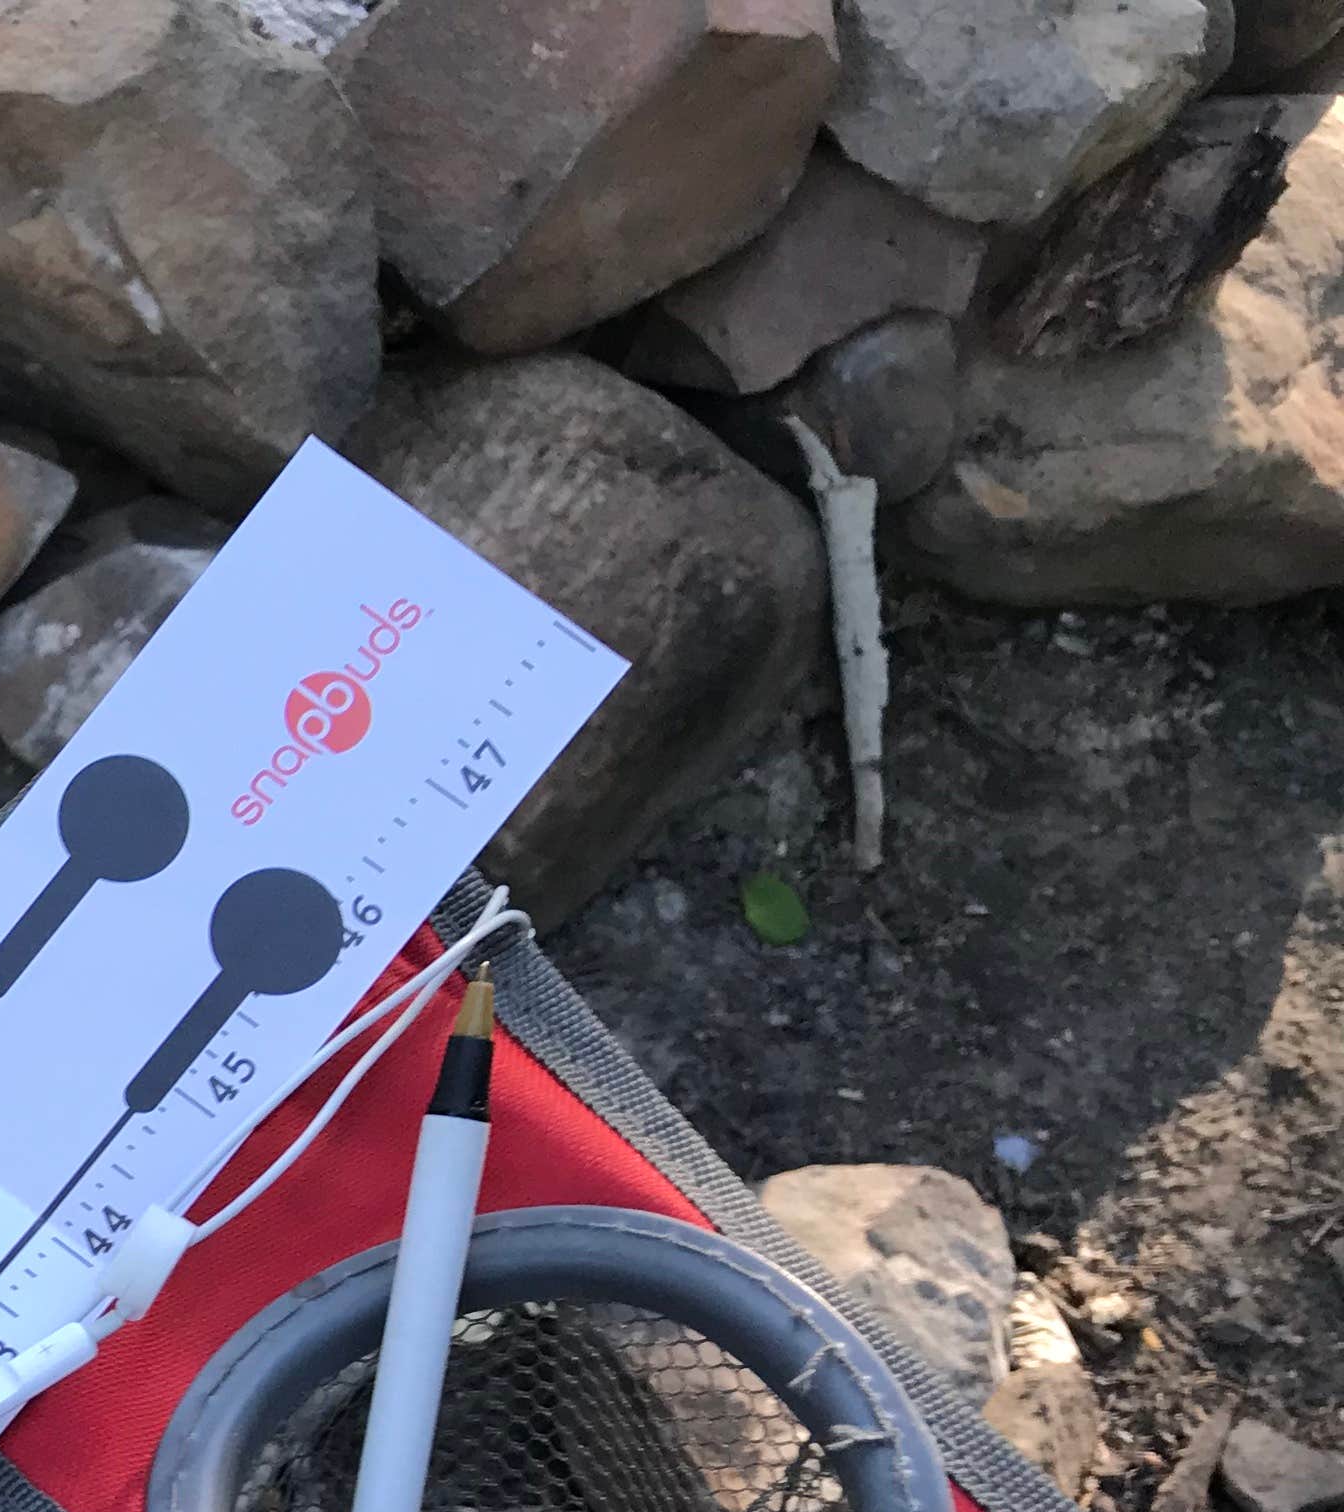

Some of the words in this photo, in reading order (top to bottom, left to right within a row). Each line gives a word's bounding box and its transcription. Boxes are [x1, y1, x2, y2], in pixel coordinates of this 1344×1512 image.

[230, 598, 422, 827] snapbuds
[461, 738, 506, 794] 47
[208, 1051, 257, 1105] 45
[83, 1205, 133, 1256] 44
